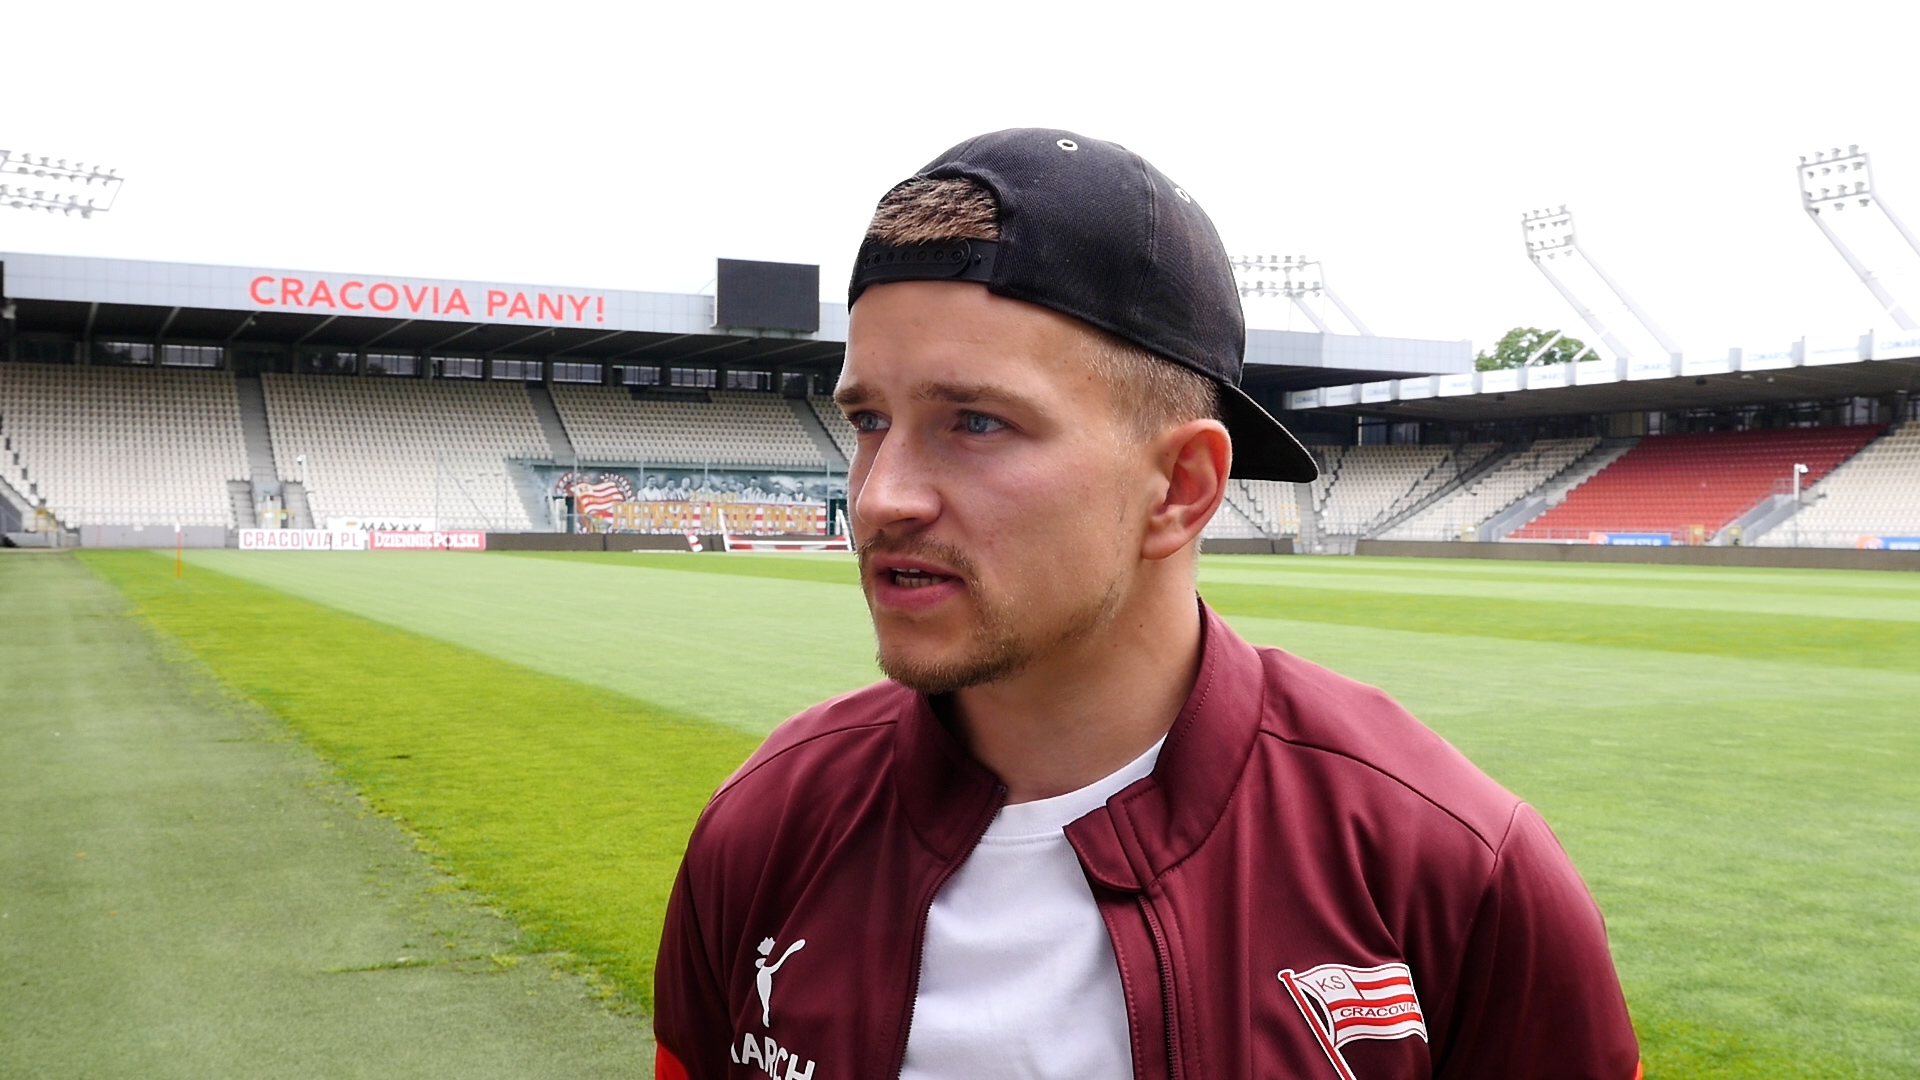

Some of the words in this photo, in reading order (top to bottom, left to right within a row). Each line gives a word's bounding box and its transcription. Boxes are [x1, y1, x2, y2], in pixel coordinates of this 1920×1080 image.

[249, 275, 471, 316] CRACOVIA
[487, 289, 605, 323] PANY!
[243, 531, 359, 547] CRACOVIA.PL
[374, 533, 432, 548] DZIENNIK
[433, 532, 480, 548] POLSKI
[1315, 975, 1346, 992] KS
[1340, 1002, 1416, 1018] CRACOVIA
[731, 1032, 816, 1080] ARCH
